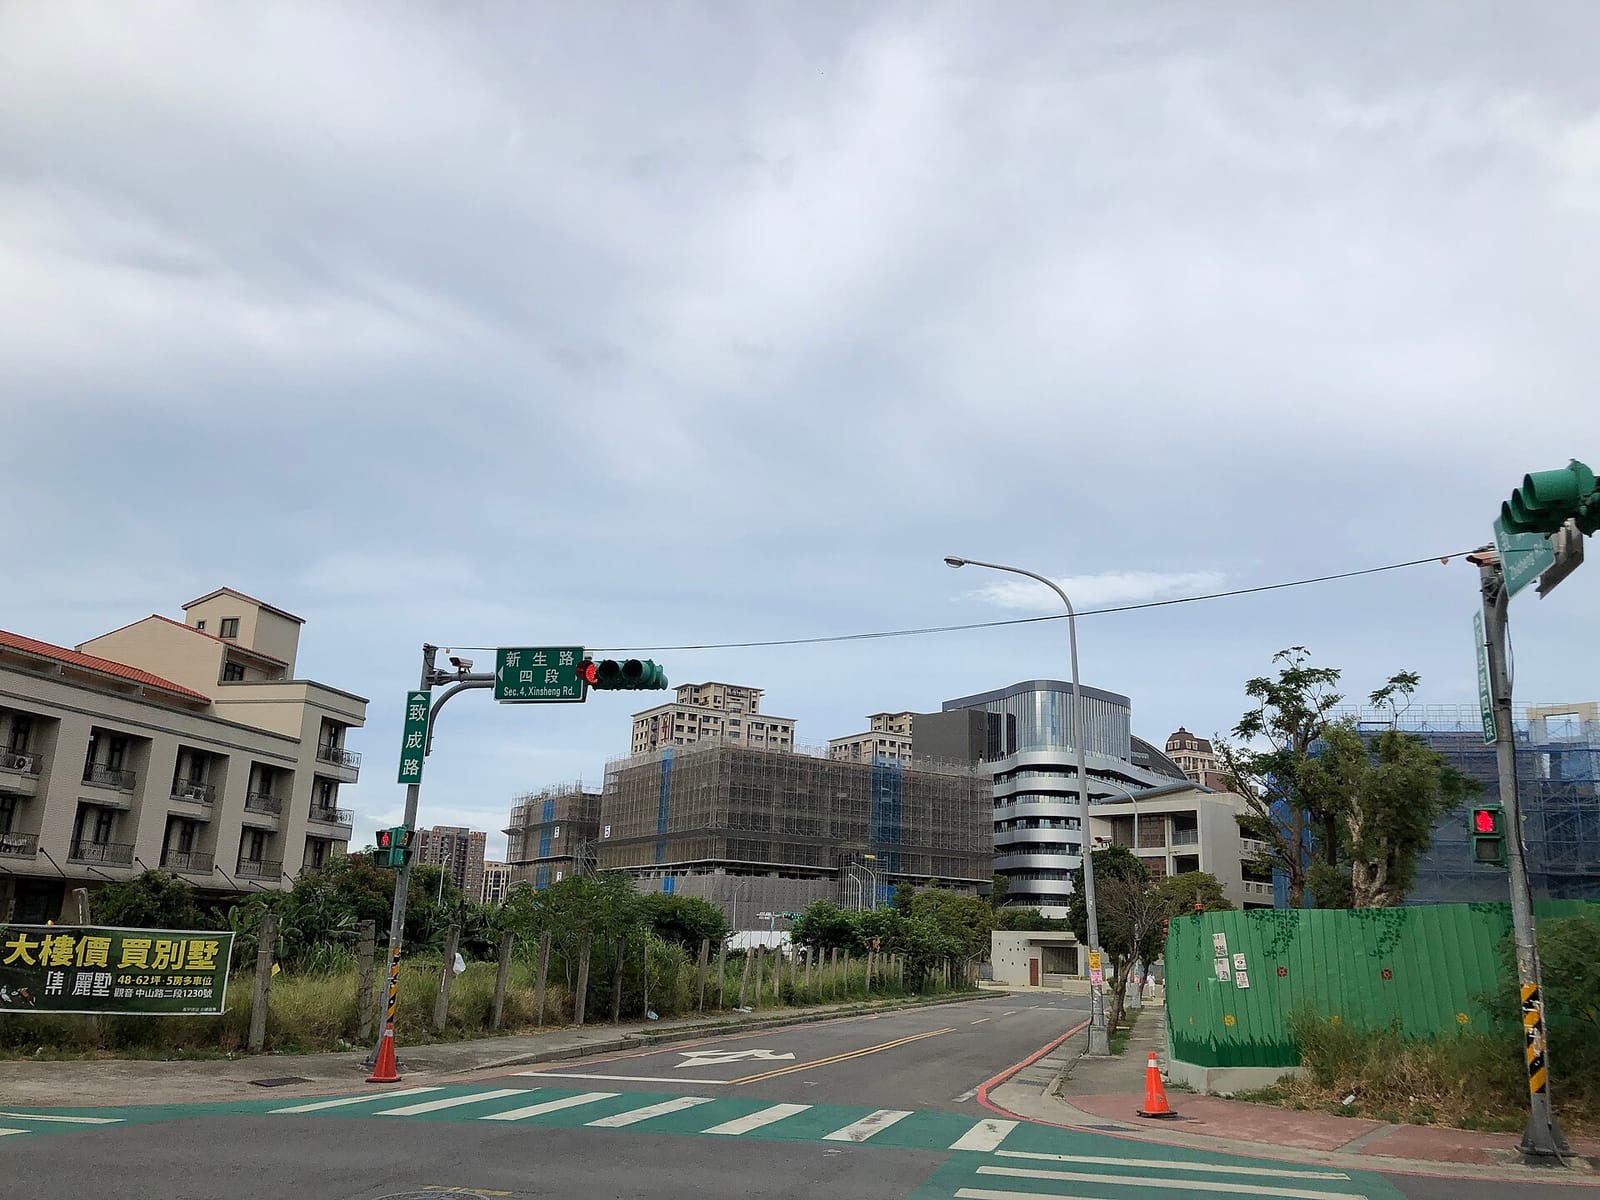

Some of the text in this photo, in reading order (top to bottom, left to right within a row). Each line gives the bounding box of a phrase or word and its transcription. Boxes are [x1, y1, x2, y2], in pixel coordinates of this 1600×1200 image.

[506, 651, 575, 668] 新生路
[520, 669, 560, 684] 四段
[503, 686, 518, 697] Sec.
[528, 685, 561, 697] Xinsheng
[562, 685, 575, 696] Rd.
[402, 704, 427, 776] 致成路
[3, 933, 220, 971] 大樓價 買別墅
